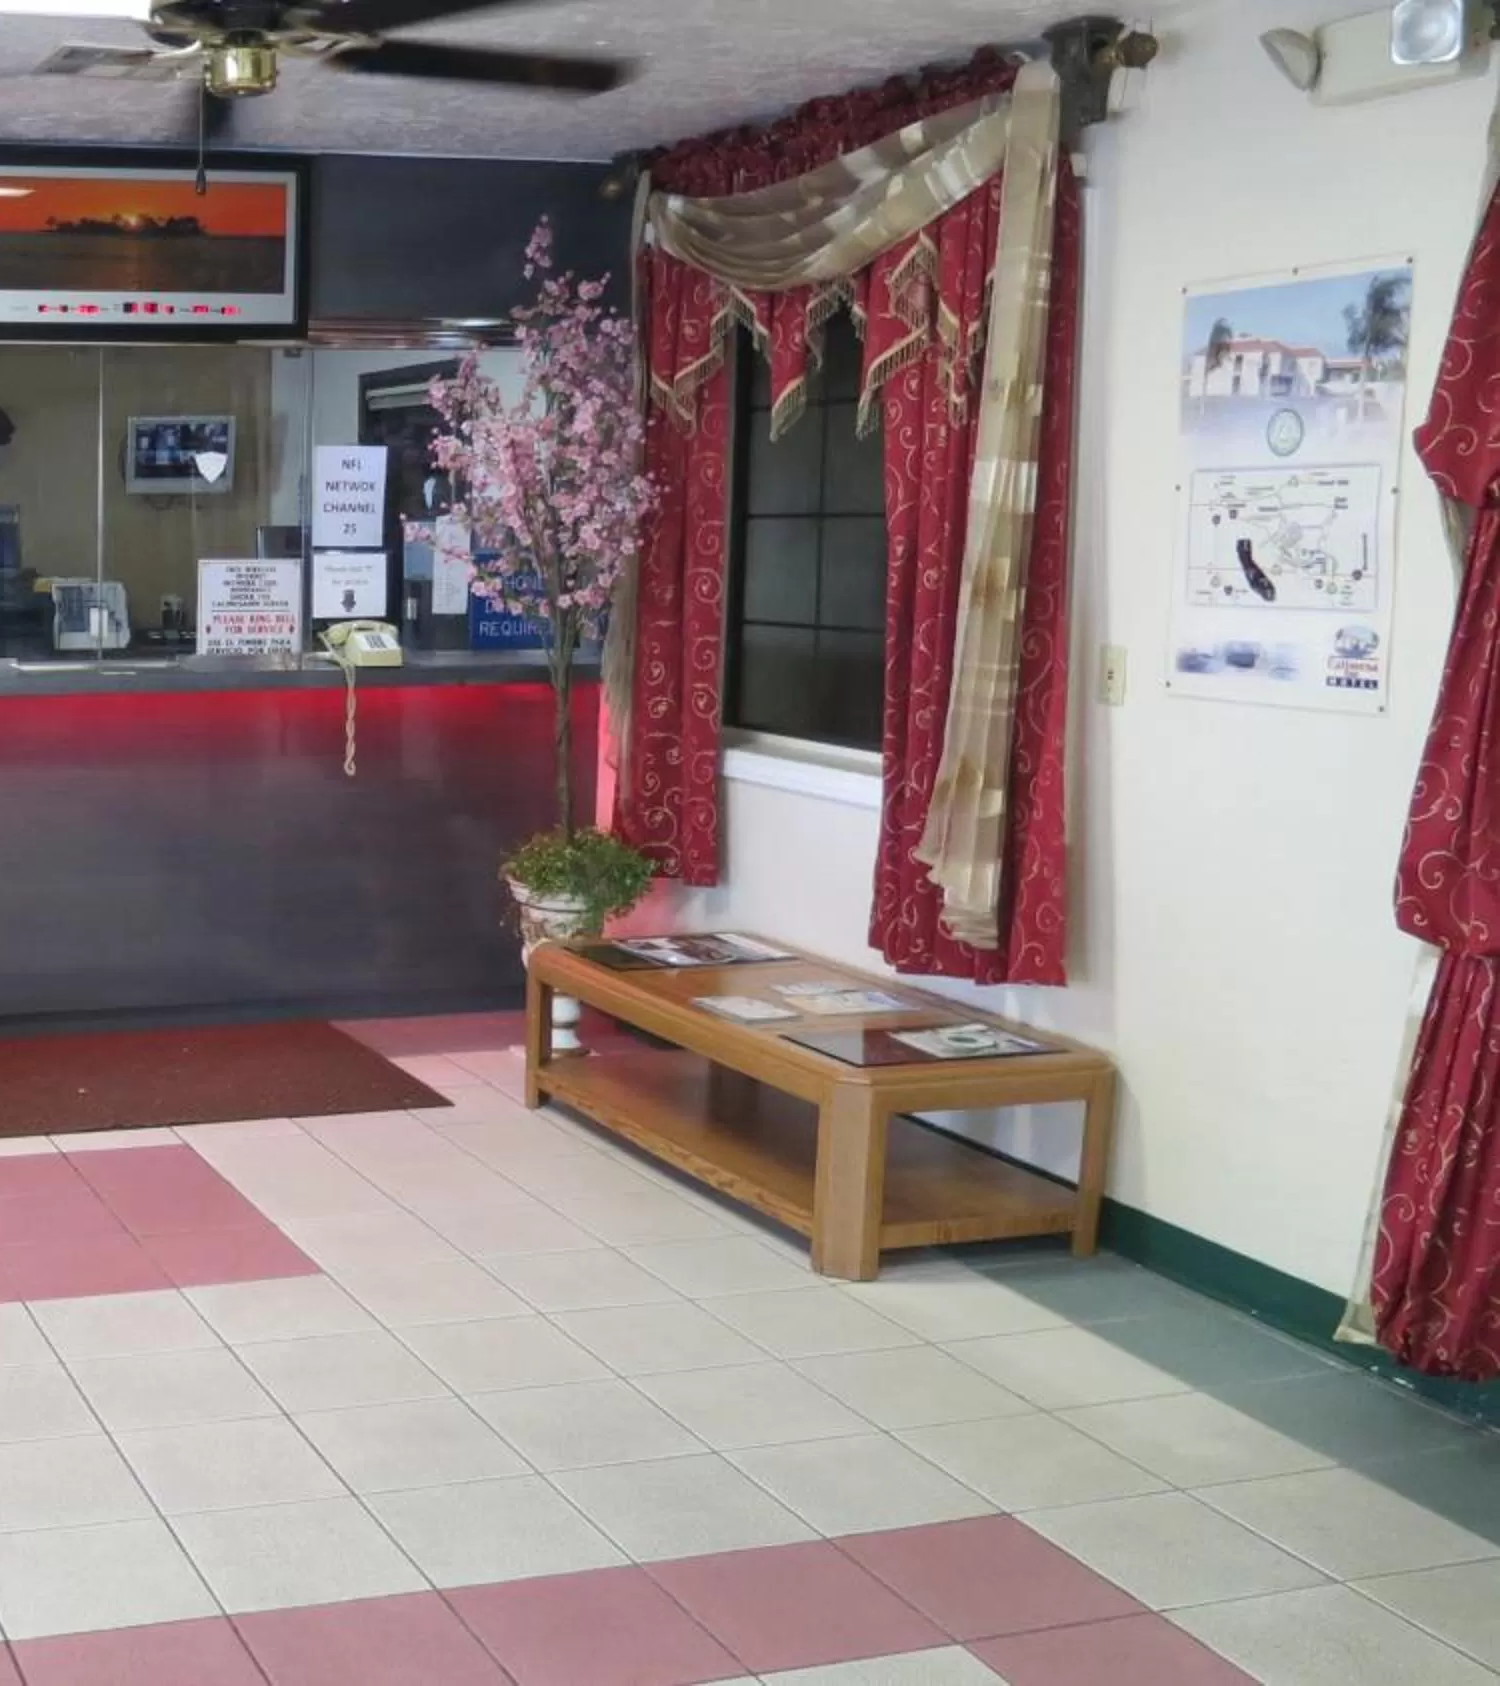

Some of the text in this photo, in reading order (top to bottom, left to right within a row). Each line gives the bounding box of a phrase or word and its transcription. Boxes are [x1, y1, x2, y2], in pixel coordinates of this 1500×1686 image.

[341, 459, 362, 471] NFL
[323, 503, 376, 514] CHANNEL
[343, 523, 358, 535] 25
[213, 615, 245, 624] PLEASE
[225, 625, 284, 634] FOR SERVICE
